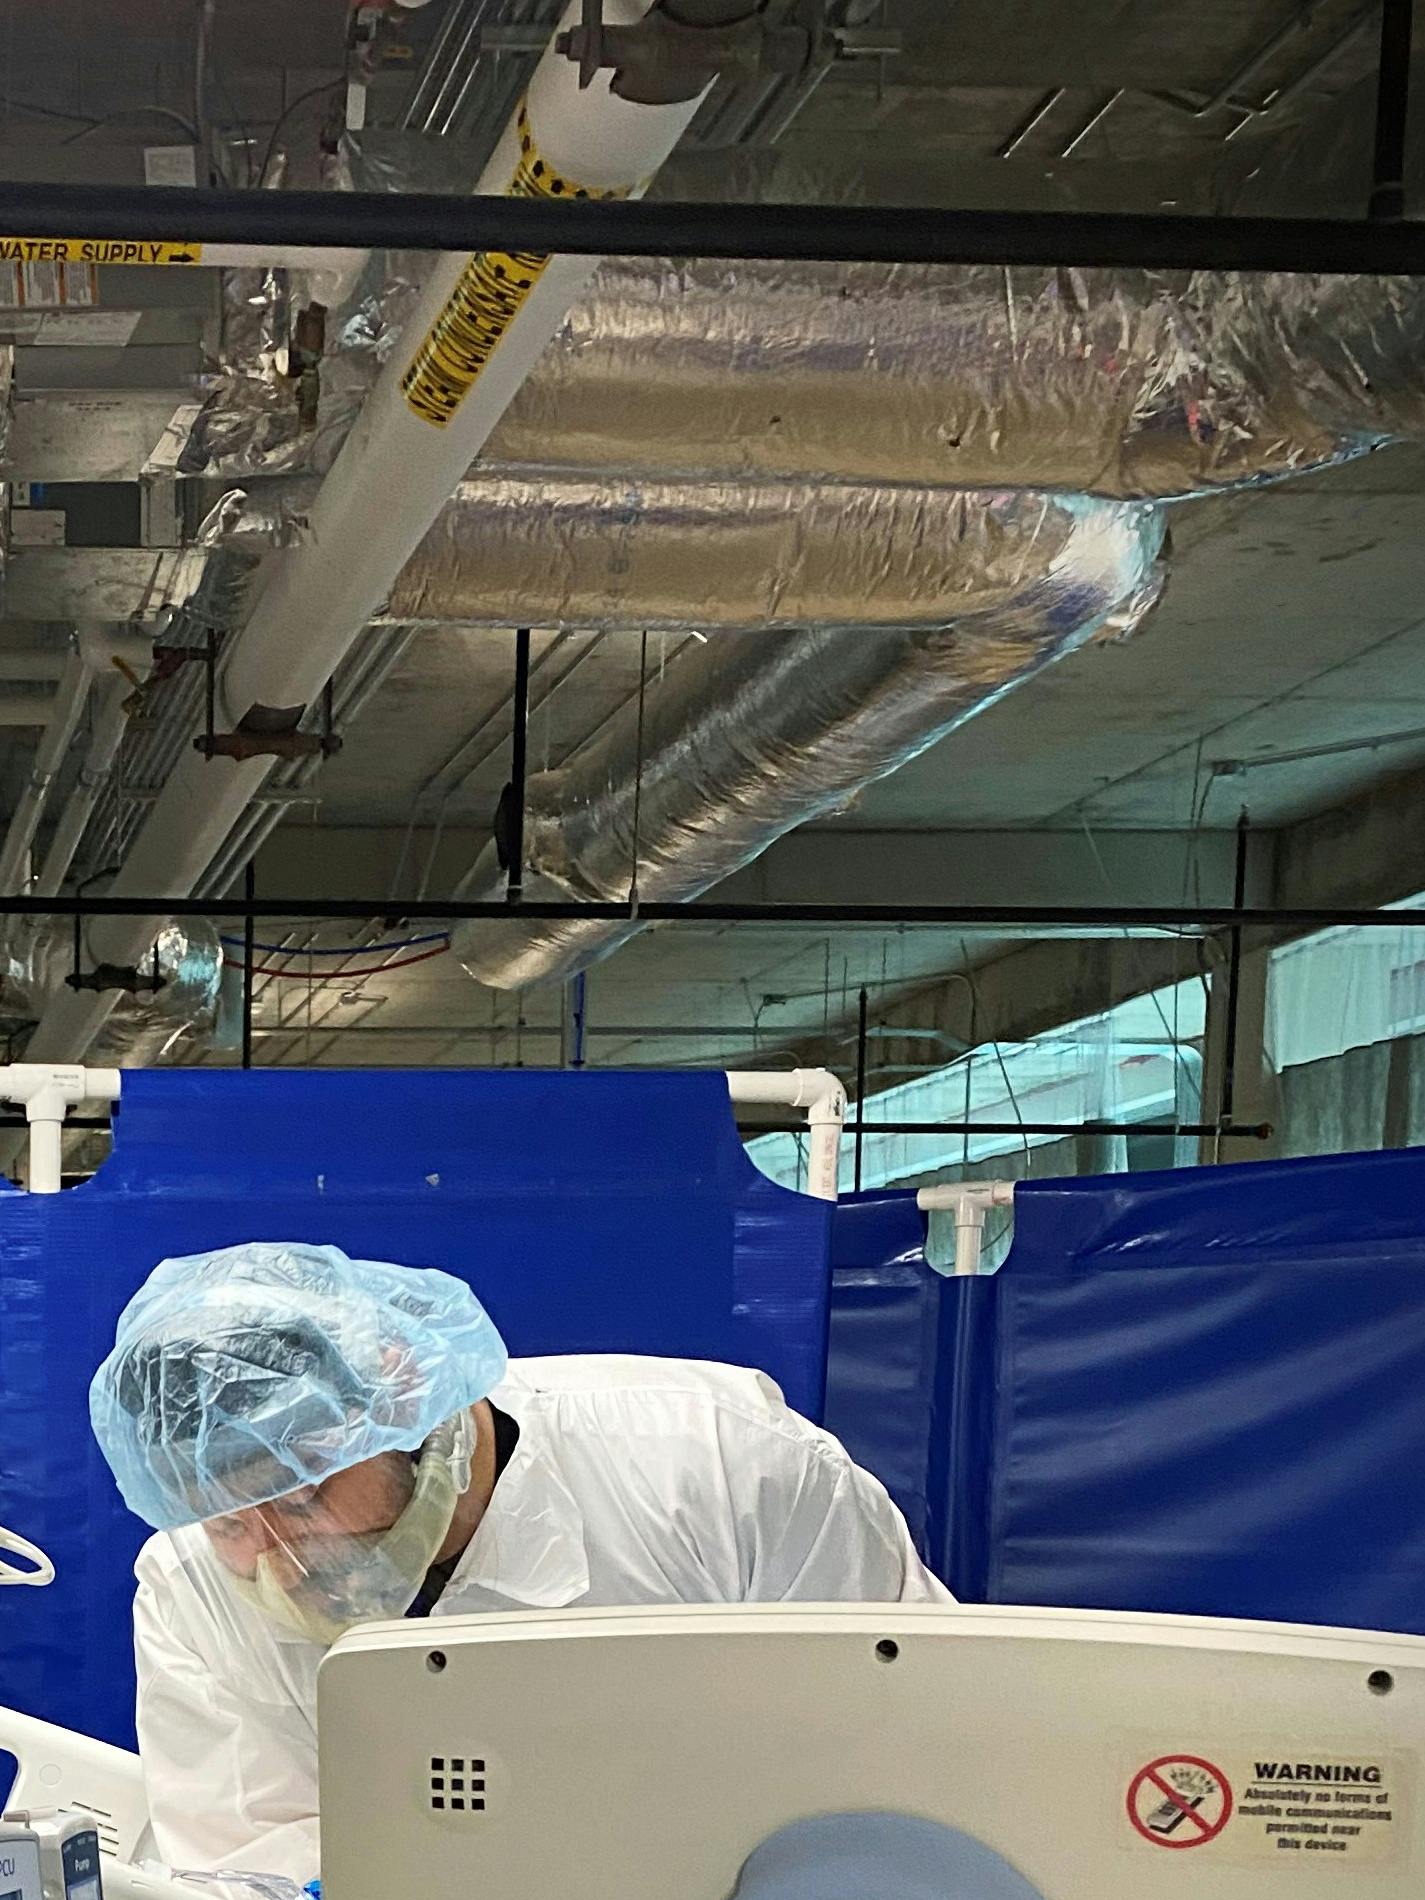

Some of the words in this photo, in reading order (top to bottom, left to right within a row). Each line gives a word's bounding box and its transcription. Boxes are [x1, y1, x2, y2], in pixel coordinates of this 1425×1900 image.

[80, 243, 163, 263] SUPPLY
[1253, 1762, 1381, 1783] WARNING
[1244, 1787, 1312, 1805] Absolutely
[1315, 1792, 1331, 1803] no
[1335, 1791, 1371, 1804] forms
[1375, 1792, 1389, 1804] of
[1238, 1805, 1282, 1817] mobile
[1286, 1807, 1392, 1821] communications
[1266, 1823, 1328, 1834] permitted
[1331, 1825, 1361, 1836] near
[1277, 1837, 1301, 1849] this
[1304, 1839, 1347, 1851] device
